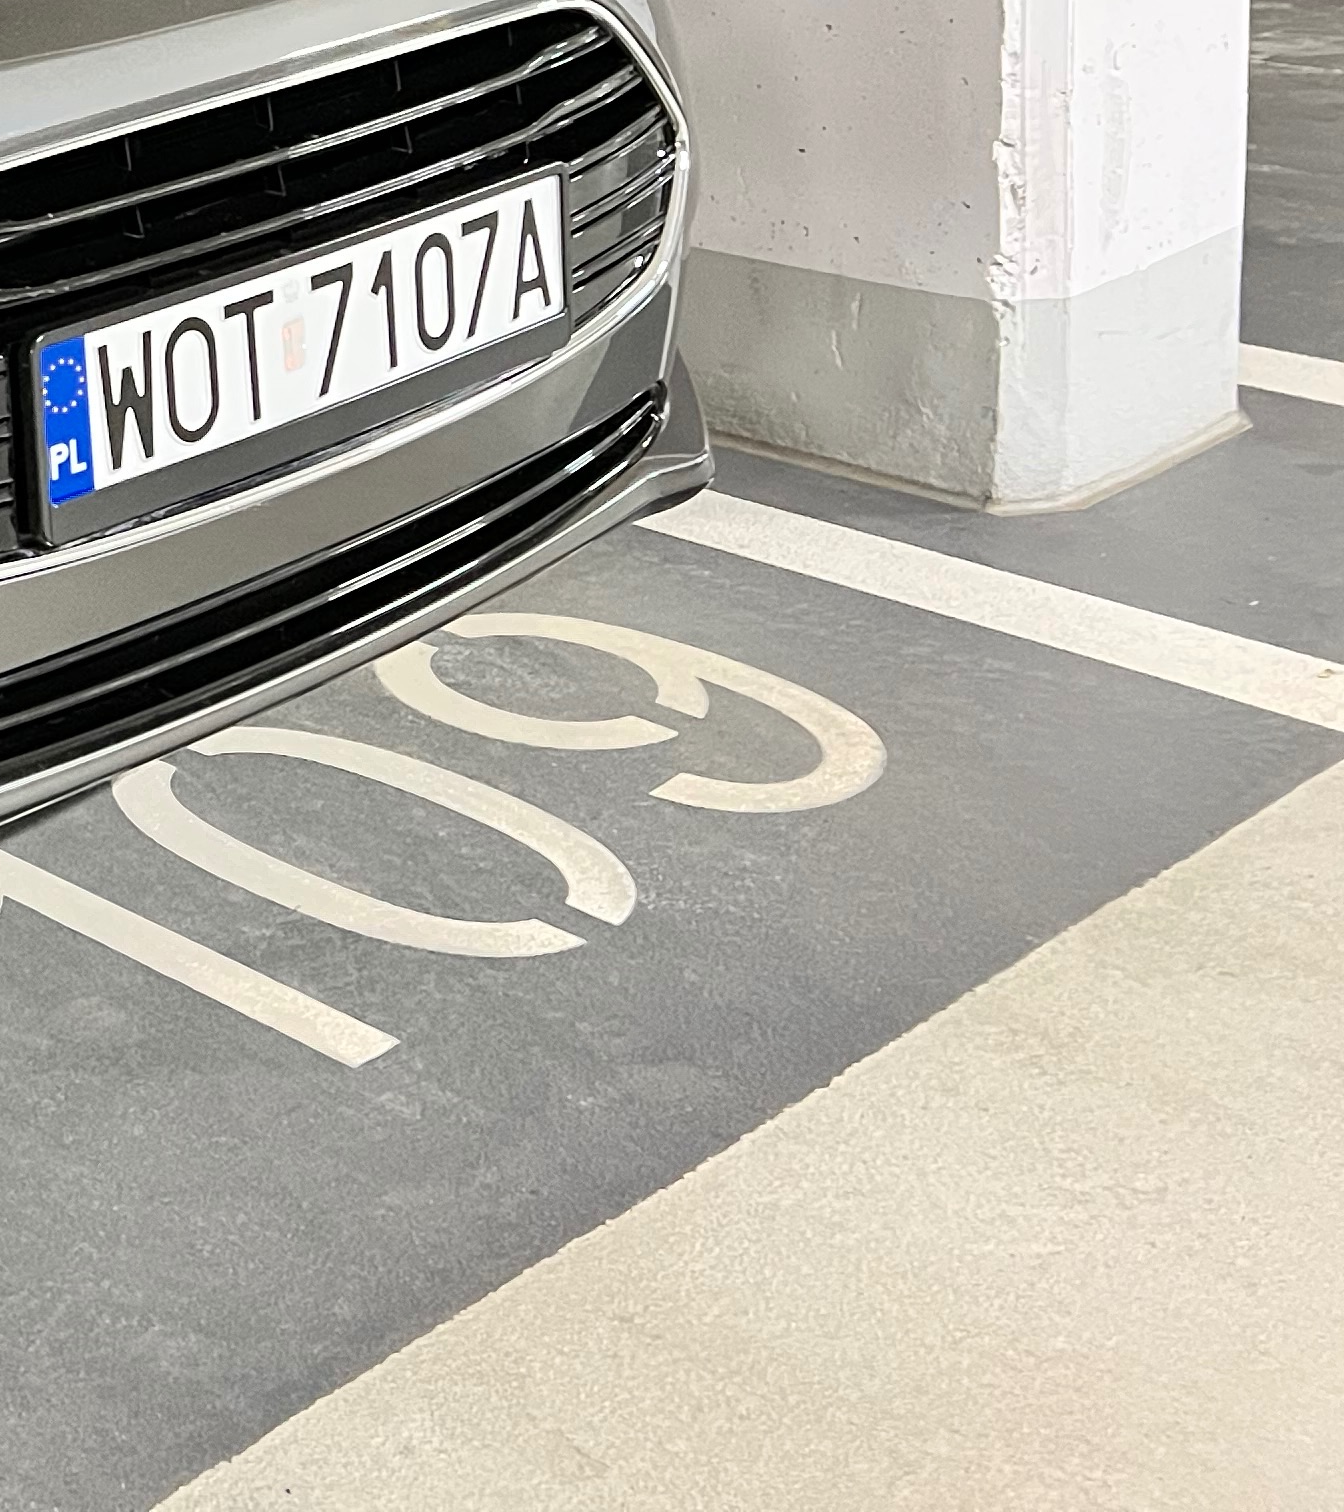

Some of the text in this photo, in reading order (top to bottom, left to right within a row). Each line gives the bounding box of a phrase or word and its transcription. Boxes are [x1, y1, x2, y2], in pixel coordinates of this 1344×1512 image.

[98, 199, 551, 470] WOT 7107A
[50, 438, 88, 481] PL
